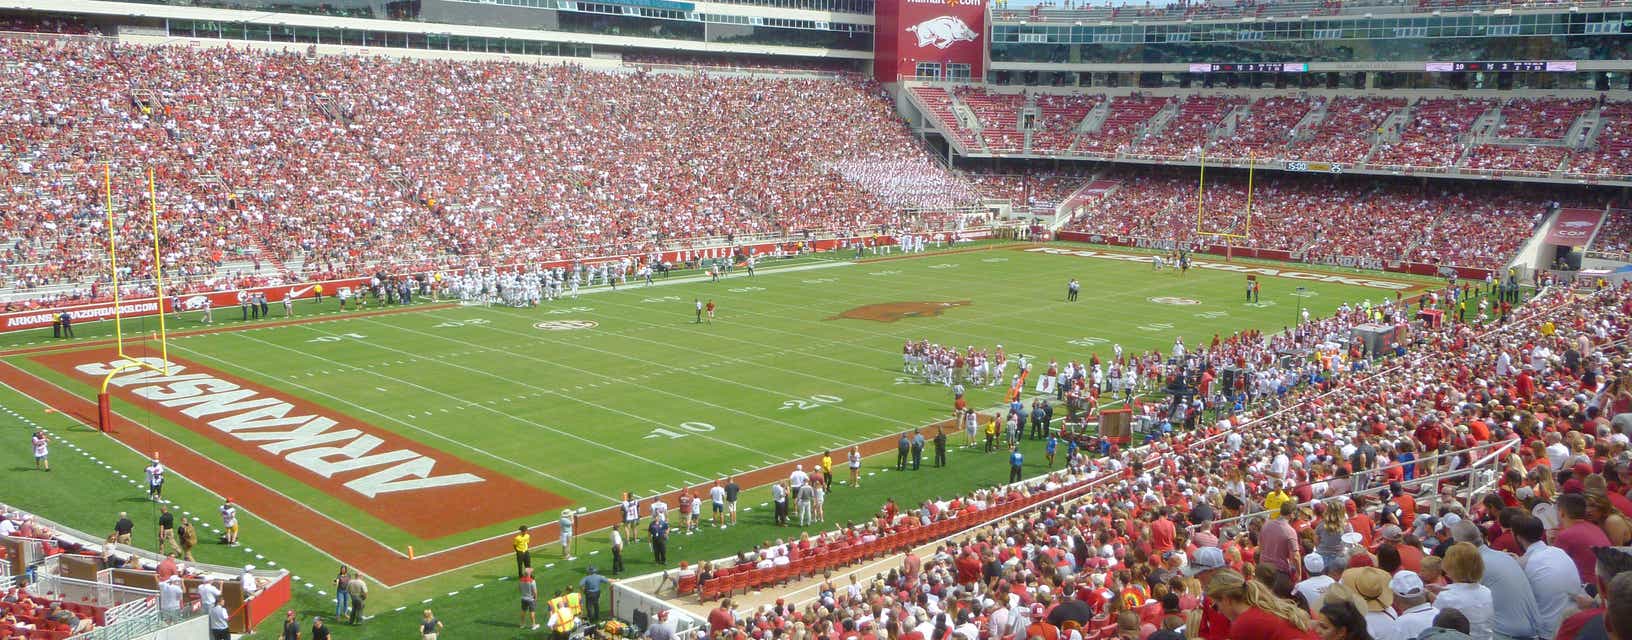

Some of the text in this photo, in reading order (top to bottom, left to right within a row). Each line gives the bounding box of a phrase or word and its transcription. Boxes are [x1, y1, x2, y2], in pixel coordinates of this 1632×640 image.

[8, 303, 157, 327] ARKANSRAZORBAKS.COM
[783, 394, 844, 410] 20
[75, 357, 485, 498] ARKANSAS
[652, 421, 716, 439] 10
